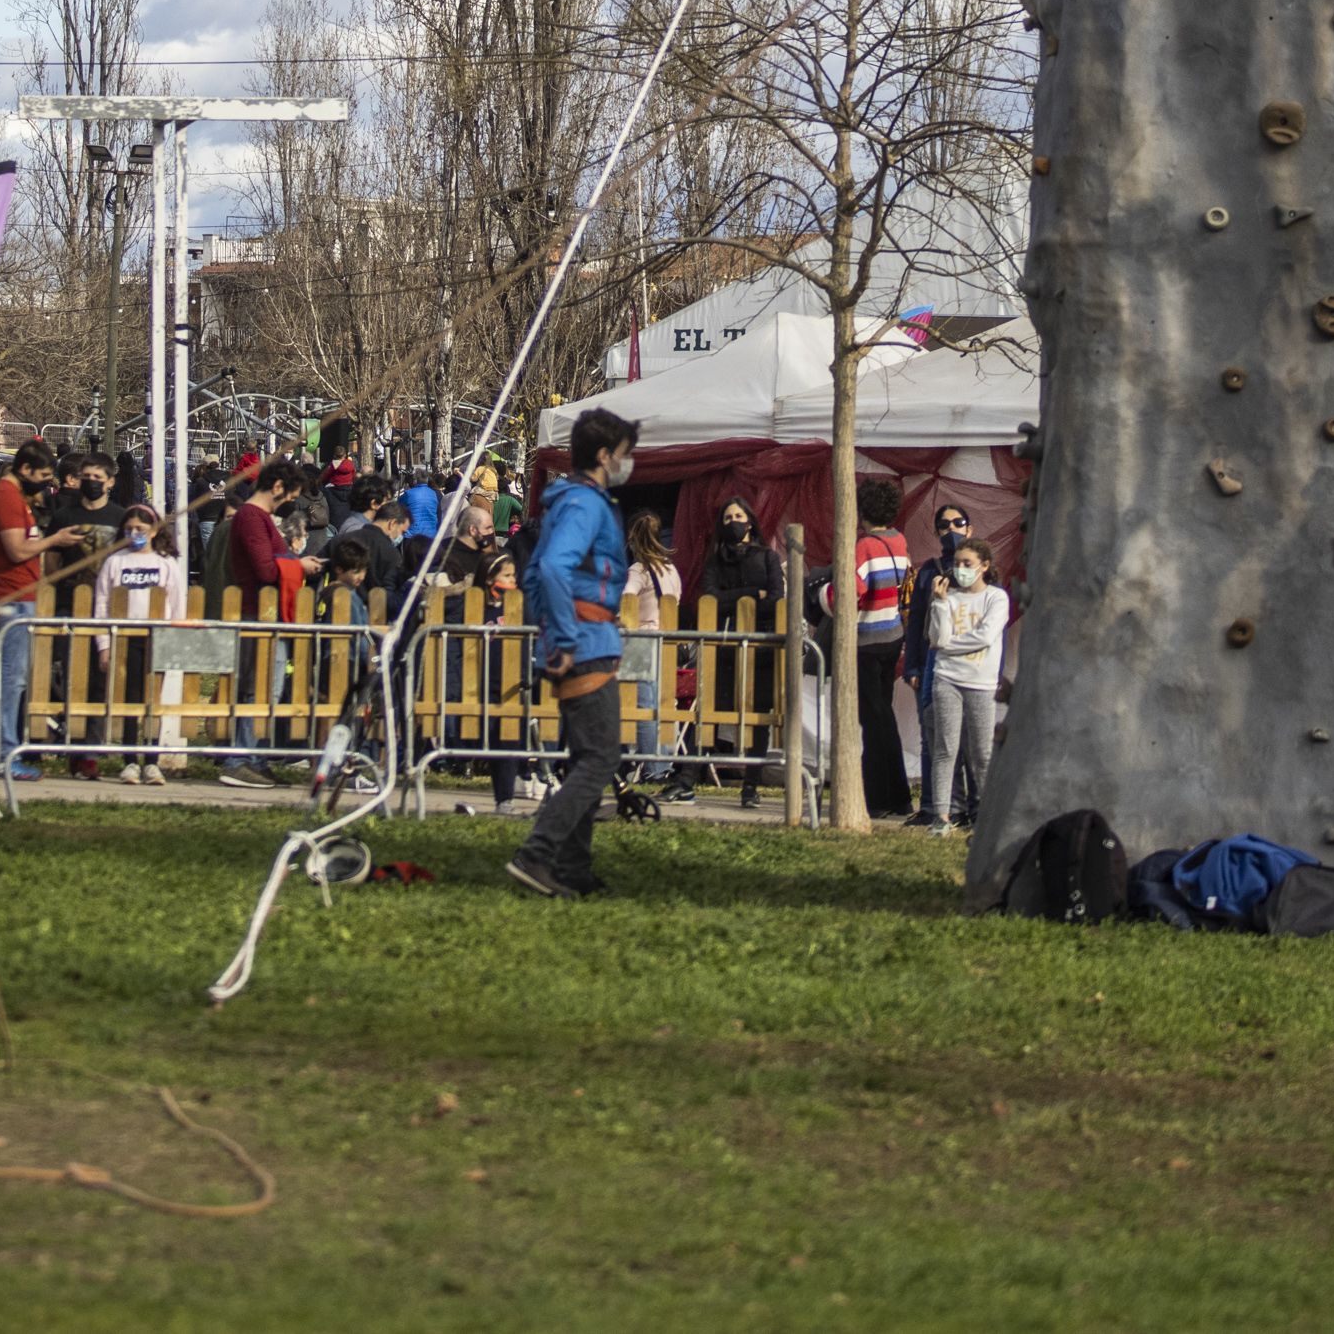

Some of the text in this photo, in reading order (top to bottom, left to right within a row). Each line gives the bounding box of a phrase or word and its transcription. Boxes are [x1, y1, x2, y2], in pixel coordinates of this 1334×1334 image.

[674, 328, 746, 351] EL T
[122, 572, 159, 584] DREAM
